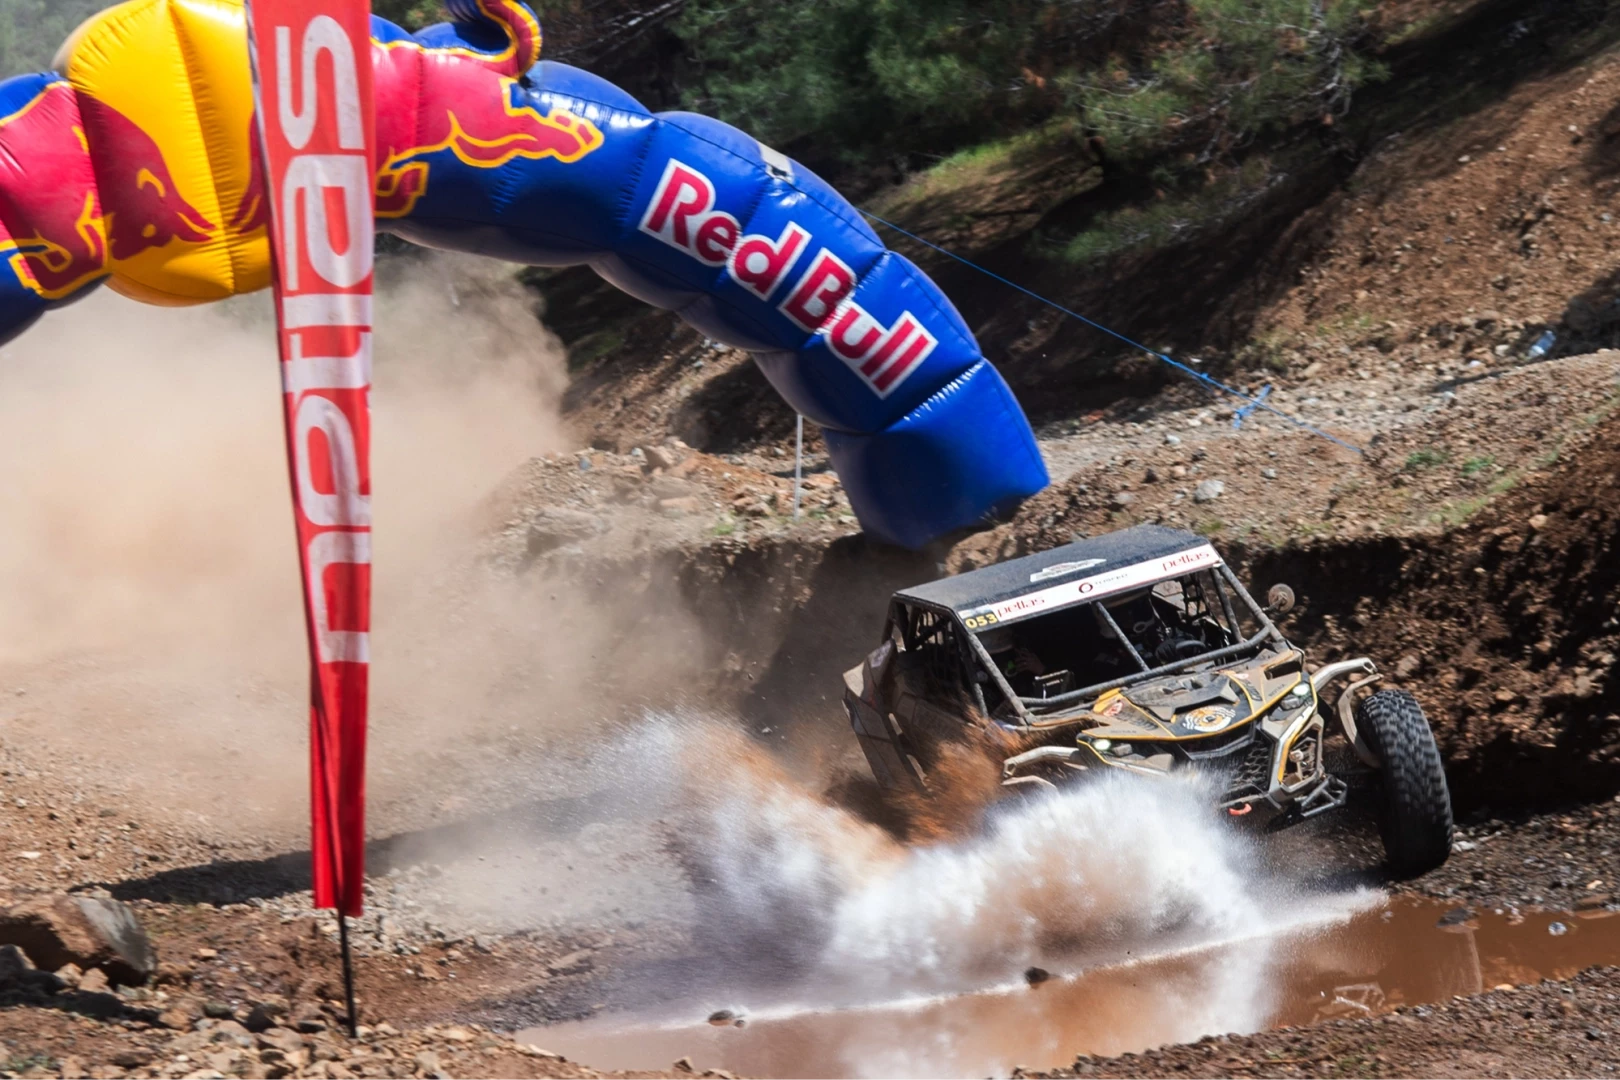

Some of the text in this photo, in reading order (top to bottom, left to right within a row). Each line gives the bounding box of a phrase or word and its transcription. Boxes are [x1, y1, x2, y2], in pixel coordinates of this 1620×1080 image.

[639, 159, 938, 398] Red Bull
[1161, 550, 1211, 572] petlas
[996, 598, 1046, 618] petlas
[965, 613, 998, 629] 053
